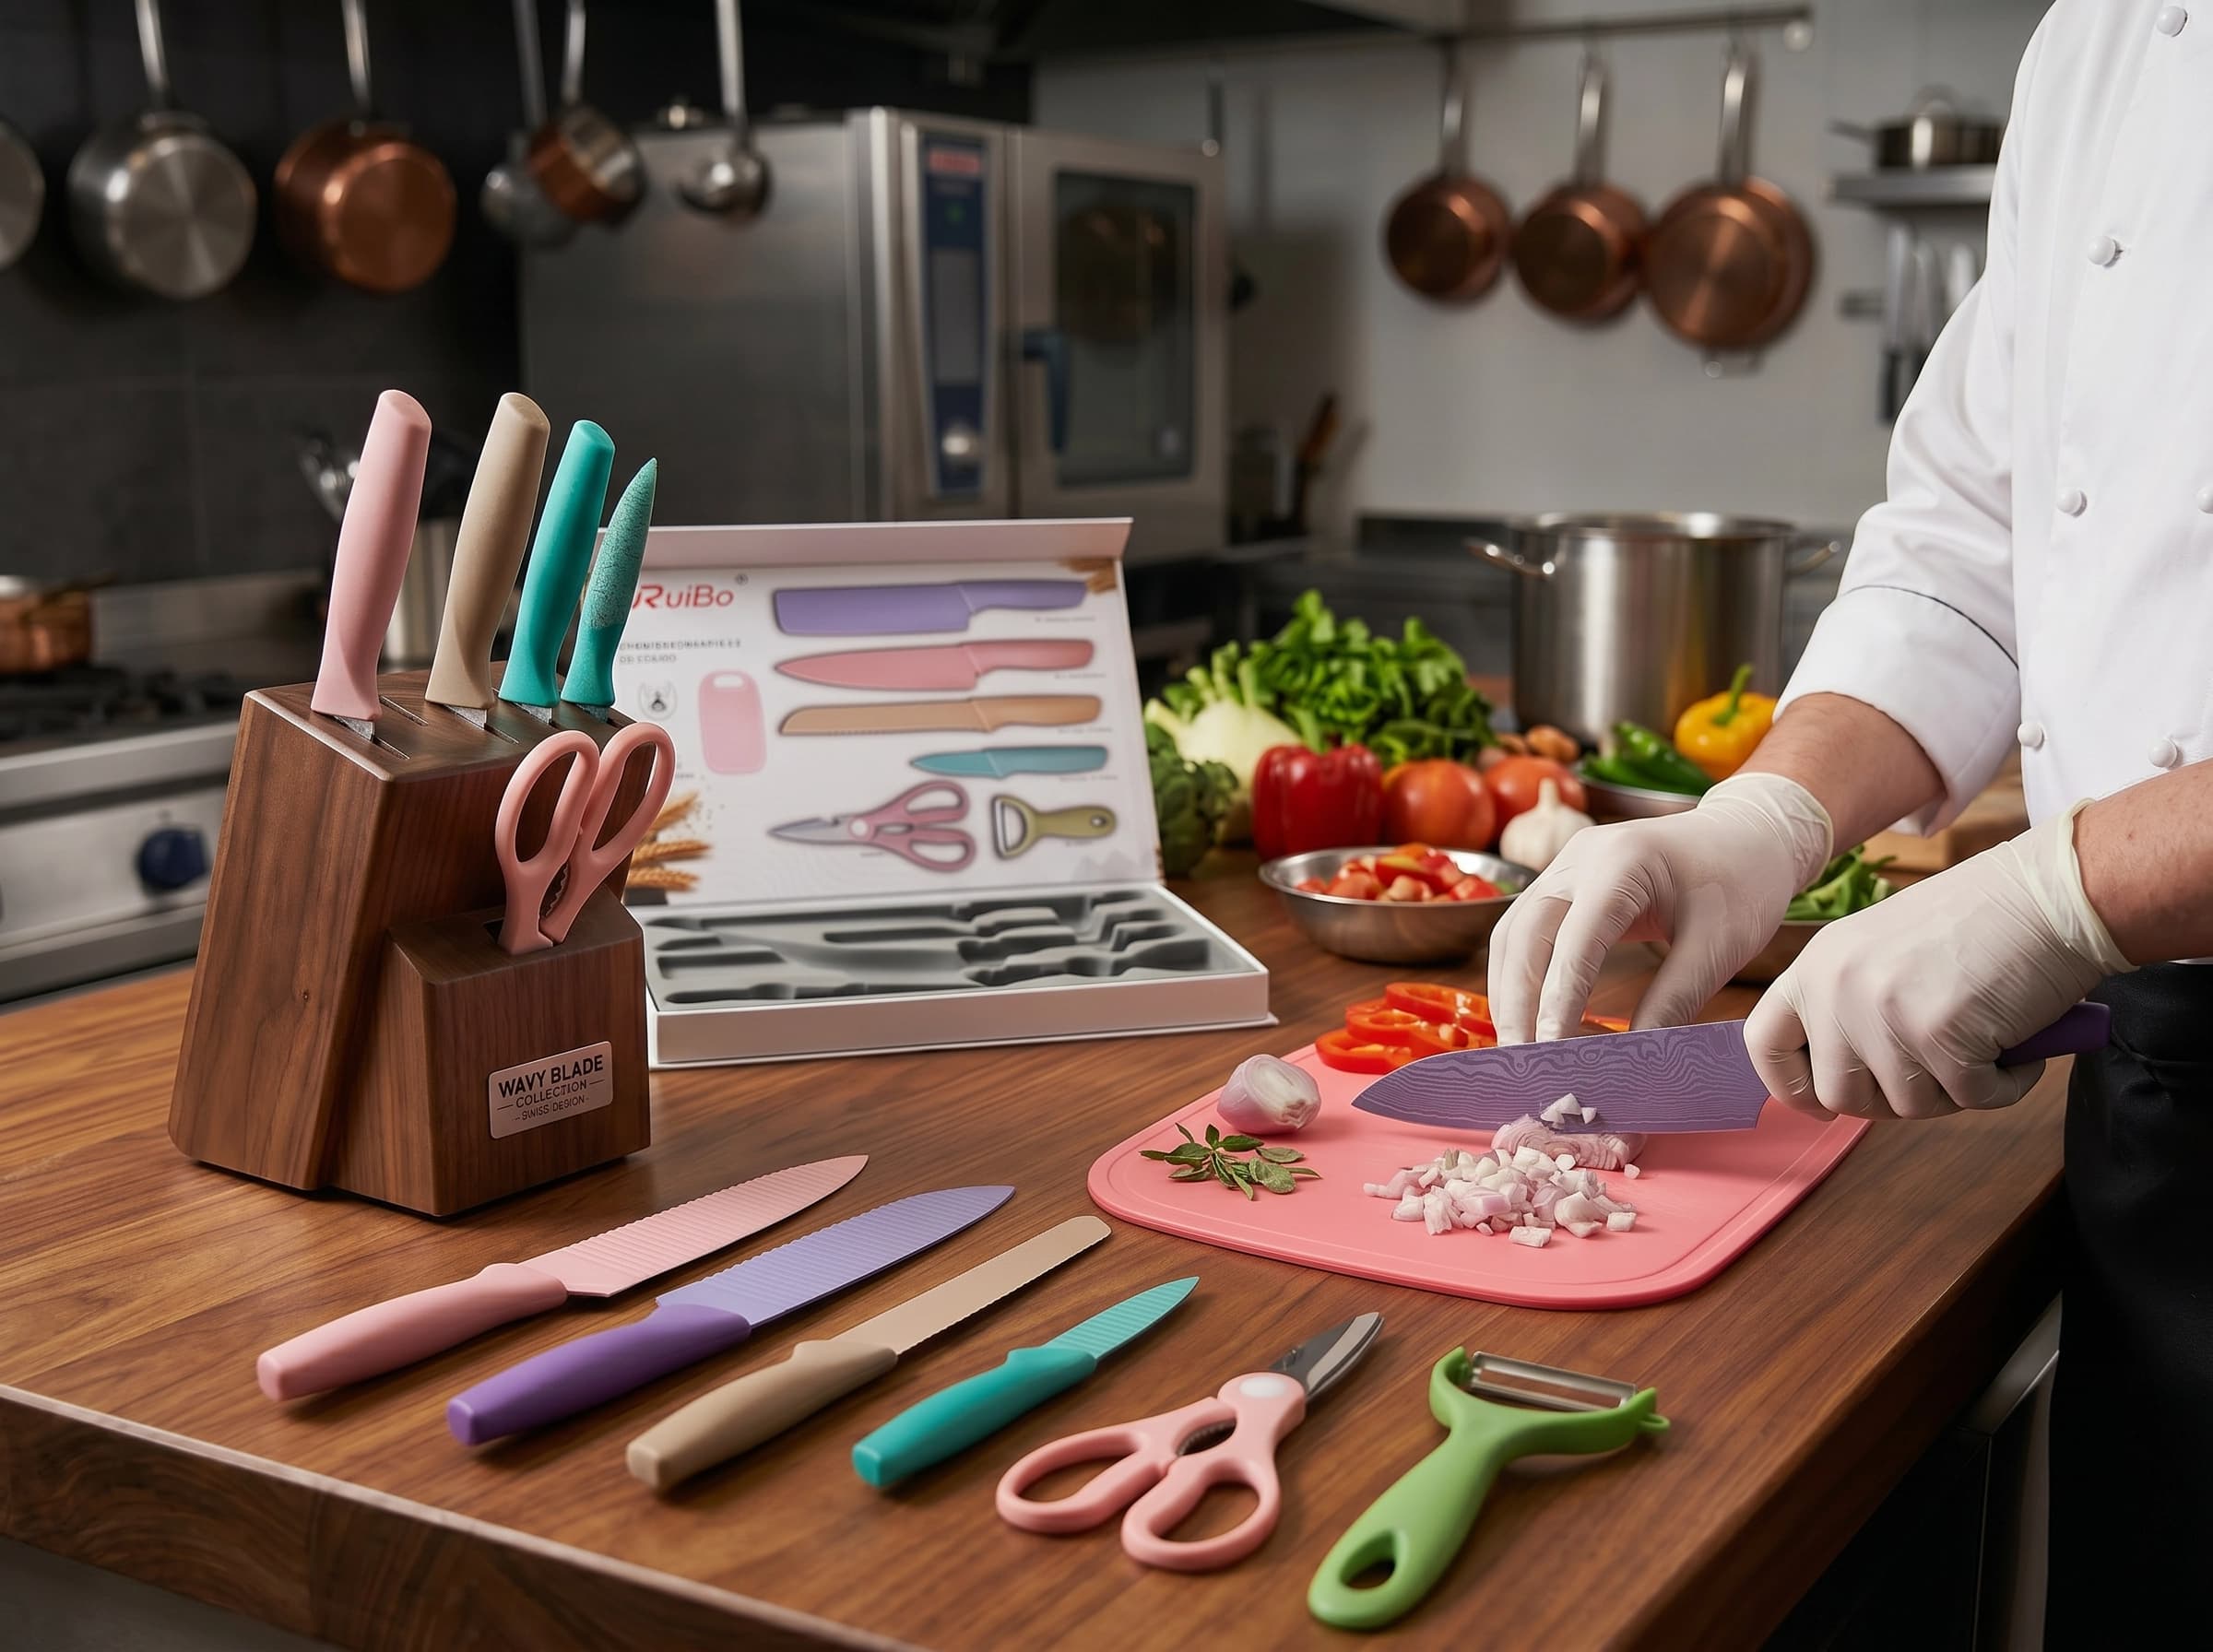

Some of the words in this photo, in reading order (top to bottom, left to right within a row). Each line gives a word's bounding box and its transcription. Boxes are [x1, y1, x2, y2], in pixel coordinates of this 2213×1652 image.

[499, 1069, 546, 1098] WAVY
[551, 1055, 604, 1084] BLADE
[516, 1079, 587, 1108] COLLECTION
